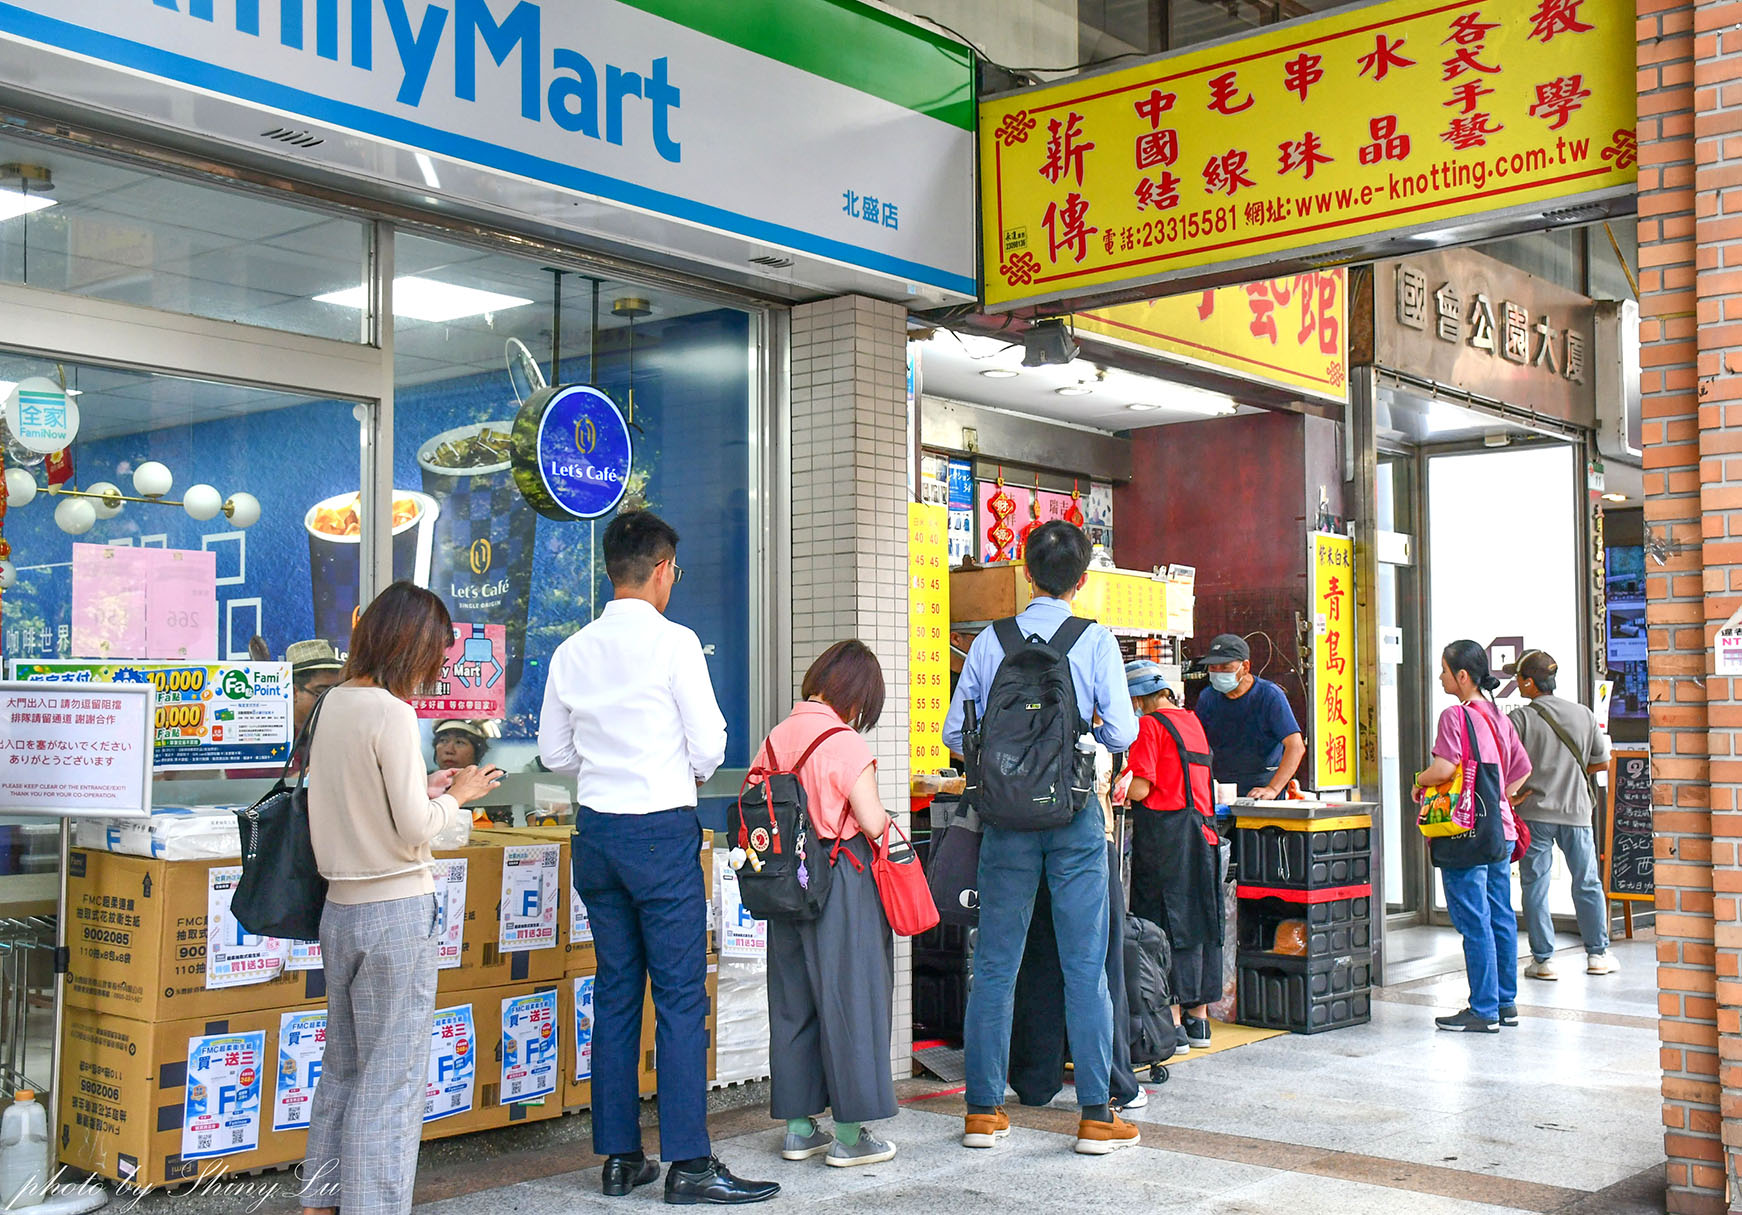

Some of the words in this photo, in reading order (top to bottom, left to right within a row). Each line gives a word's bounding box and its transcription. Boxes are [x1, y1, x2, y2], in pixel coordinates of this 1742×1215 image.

[1527, 0, 1594, 130] 教學
[1439, 12, 1503, 150] 各式手藝
[1358, 34, 1416, 165] 水晶
[1277, 53, 1334, 179] 串珠
[1202, 72, 1255, 196] 毛線
[1133, 90, 1182, 211] 中國結
[1039, 111, 1098, 264] 薪傳
[842, 189, 898, 231] 北盛店
[1102, 208, 1237, 255] 電話:23315581
[1197, 268, 1339, 354] 藝館
[1394, 262, 1585, 385] 國會公園大廈
[22, 405, 65, 428] 全家
[20, 427, 67, 440] FamiNow
[586, 465, 617, 482] Café
[914, 532, 924, 543] 40
[930, 534, 939, 545] 40
[915, 555, 925, 566] 45
[930, 557, 939, 568] 45
[481, 576, 510, 598] Café
[916, 578, 925, 589] 45
[930, 579, 940, 590] 45
[931, 603, 940, 614] 50
[6, 623, 71, 656] 咖啡世界
[916, 626, 925, 637] 50
[931, 627, 940, 638] 50
[916, 651, 926, 662] 45
[930, 651, 940, 662] 45
[254, 671, 279, 683] Fami
[454, 664, 481, 677] Mart
[916, 673, 926, 685] 55
[931, 674, 941, 686] 55
[1323, 575, 1348, 776] 青島飯糰
[254, 684, 281, 697] Point
[6, 697, 58, 709] 大門出入口
[916, 698, 926, 709] 55
[931, 698, 940, 709] 55
[75, 713, 117, 725] 謝謝合作
[916, 721, 925, 733] 50
[931, 722, 940, 733] 50
[9, 754, 115, 767] ありがとうございます
[916, 745, 926, 757] 60
[931, 745, 940, 757] 60
[959, 888, 980, 909] C
[84, 927, 130, 945] 9002085
[509, 1007, 551, 1028] 買一送三
[197, 1051, 254, 1071] 買一送三
[80, 1079, 119, 1101] 9002085
[219, 1085, 236, 1115] F
